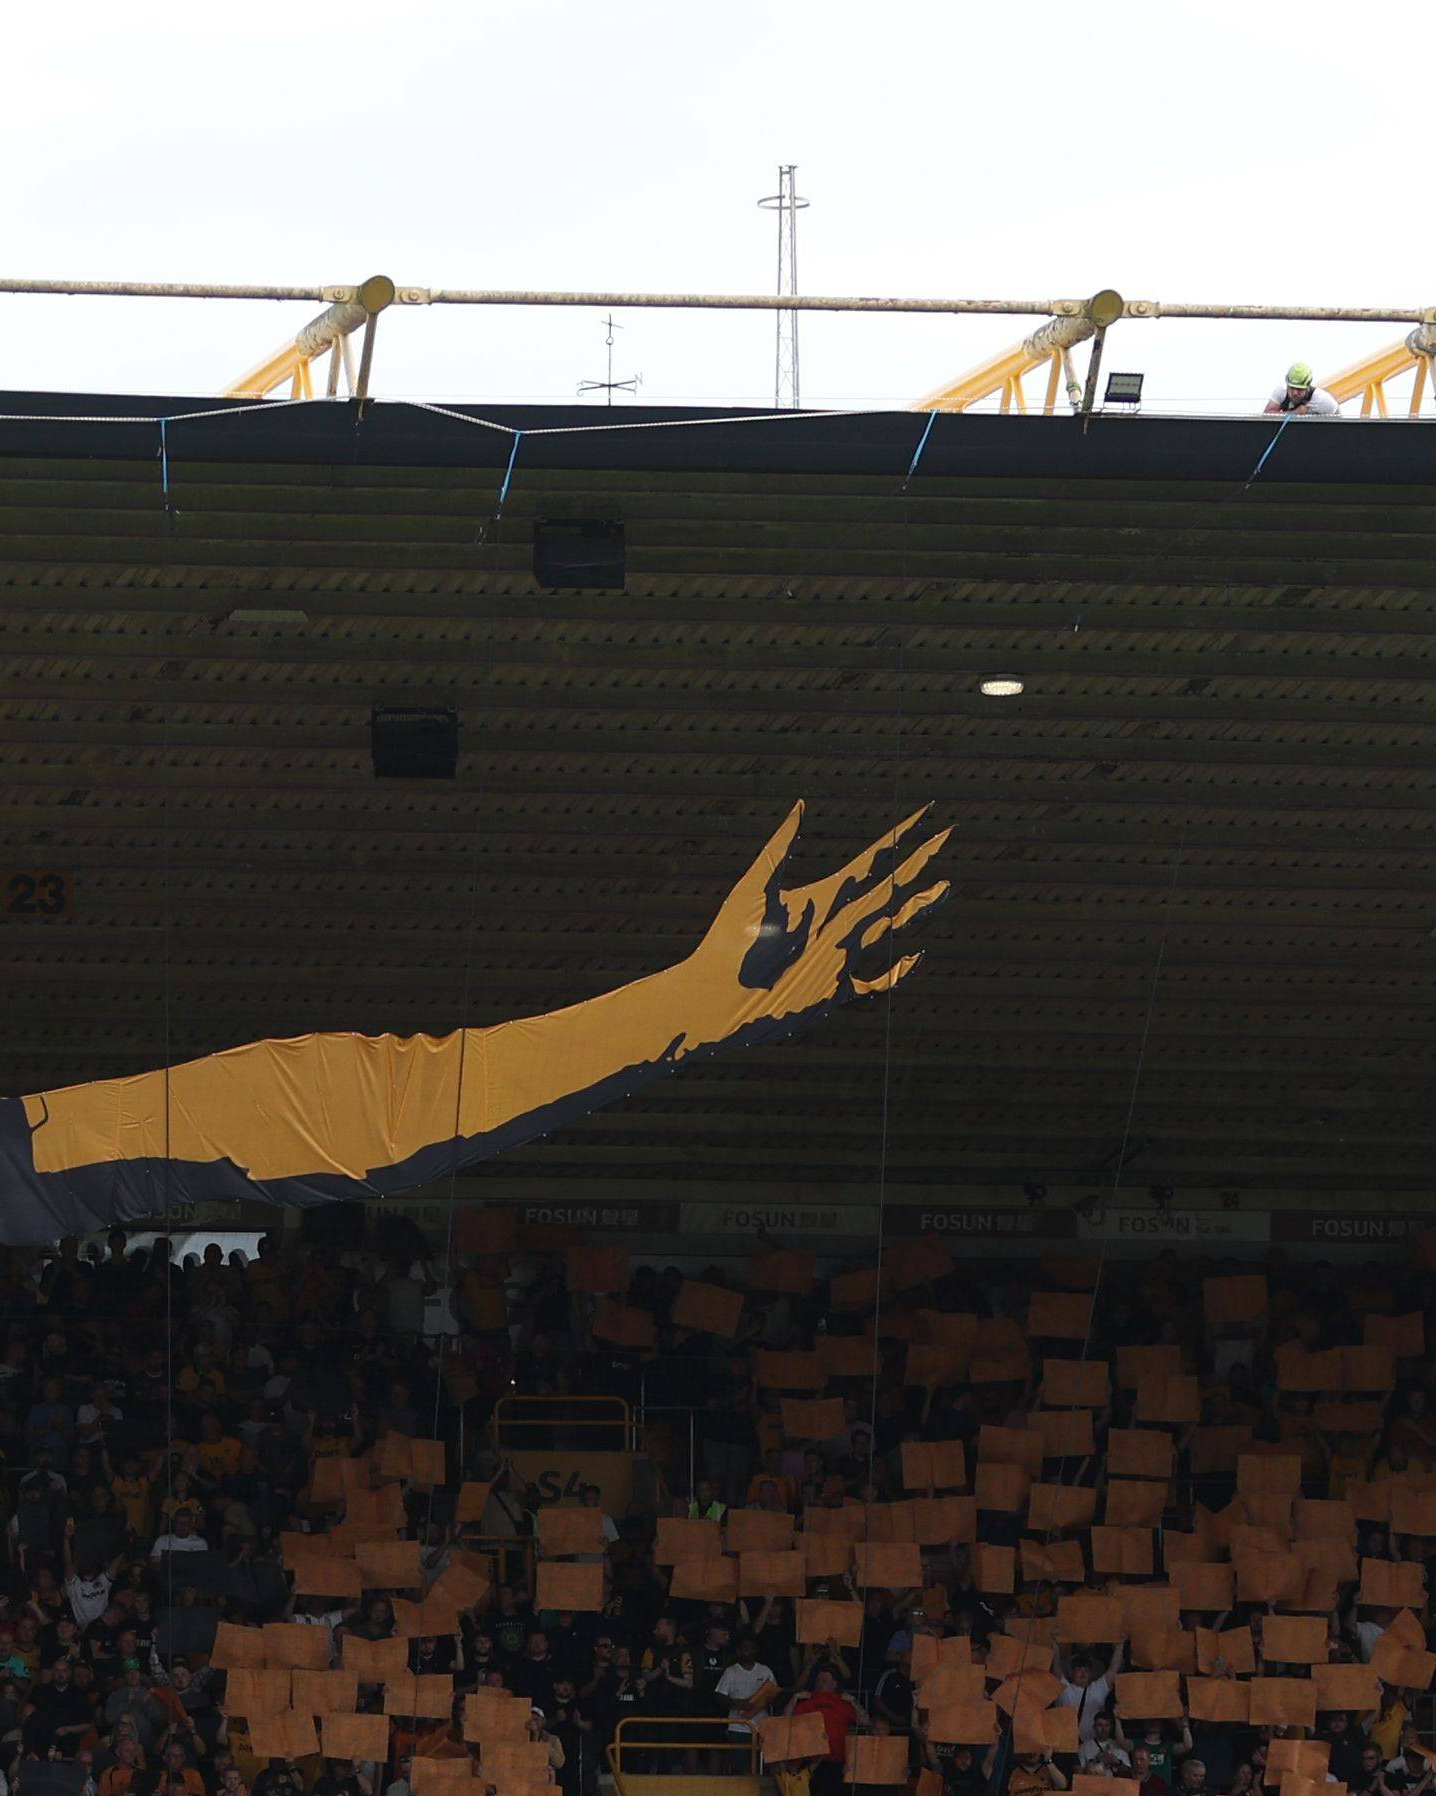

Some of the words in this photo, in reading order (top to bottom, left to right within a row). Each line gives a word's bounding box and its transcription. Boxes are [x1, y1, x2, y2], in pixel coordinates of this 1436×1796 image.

[7, 873, 64, 913] 23
[525, 1207, 599, 1225] FOSUN
[723, 1211, 795, 1228] FOSUN
[921, 1214, 992, 1230] FOSUN
[1312, 1220, 1383, 1237] FOSUN
